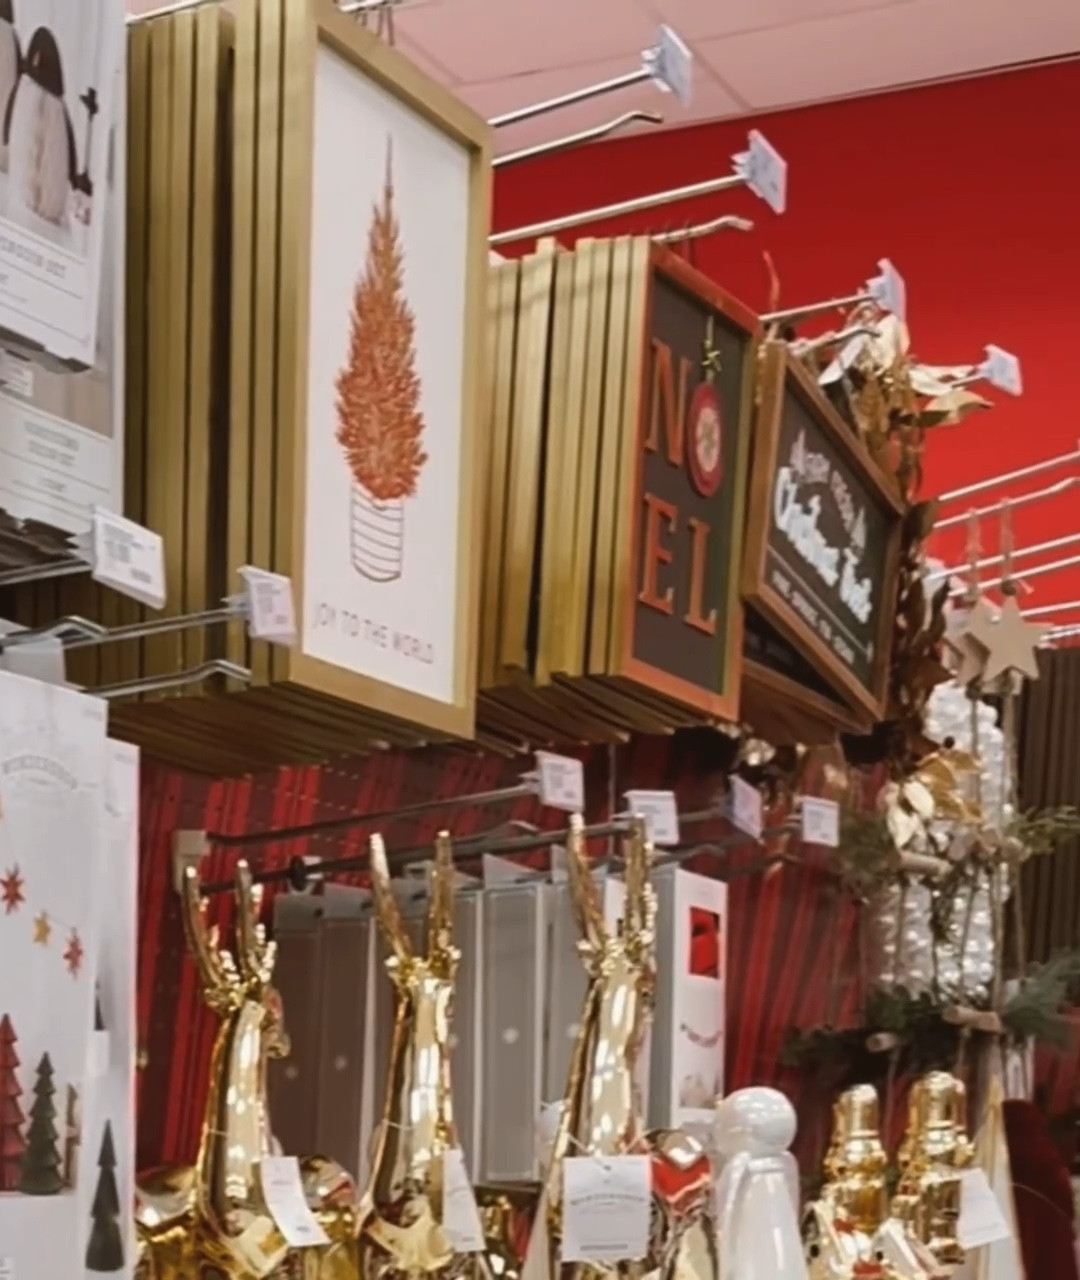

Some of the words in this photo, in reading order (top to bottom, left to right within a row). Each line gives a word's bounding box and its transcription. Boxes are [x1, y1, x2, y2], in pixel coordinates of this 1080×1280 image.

[341, 610, 360, 637] TO
[364, 618, 389, 649] THE
[392, 631, 434, 665] WORLD
